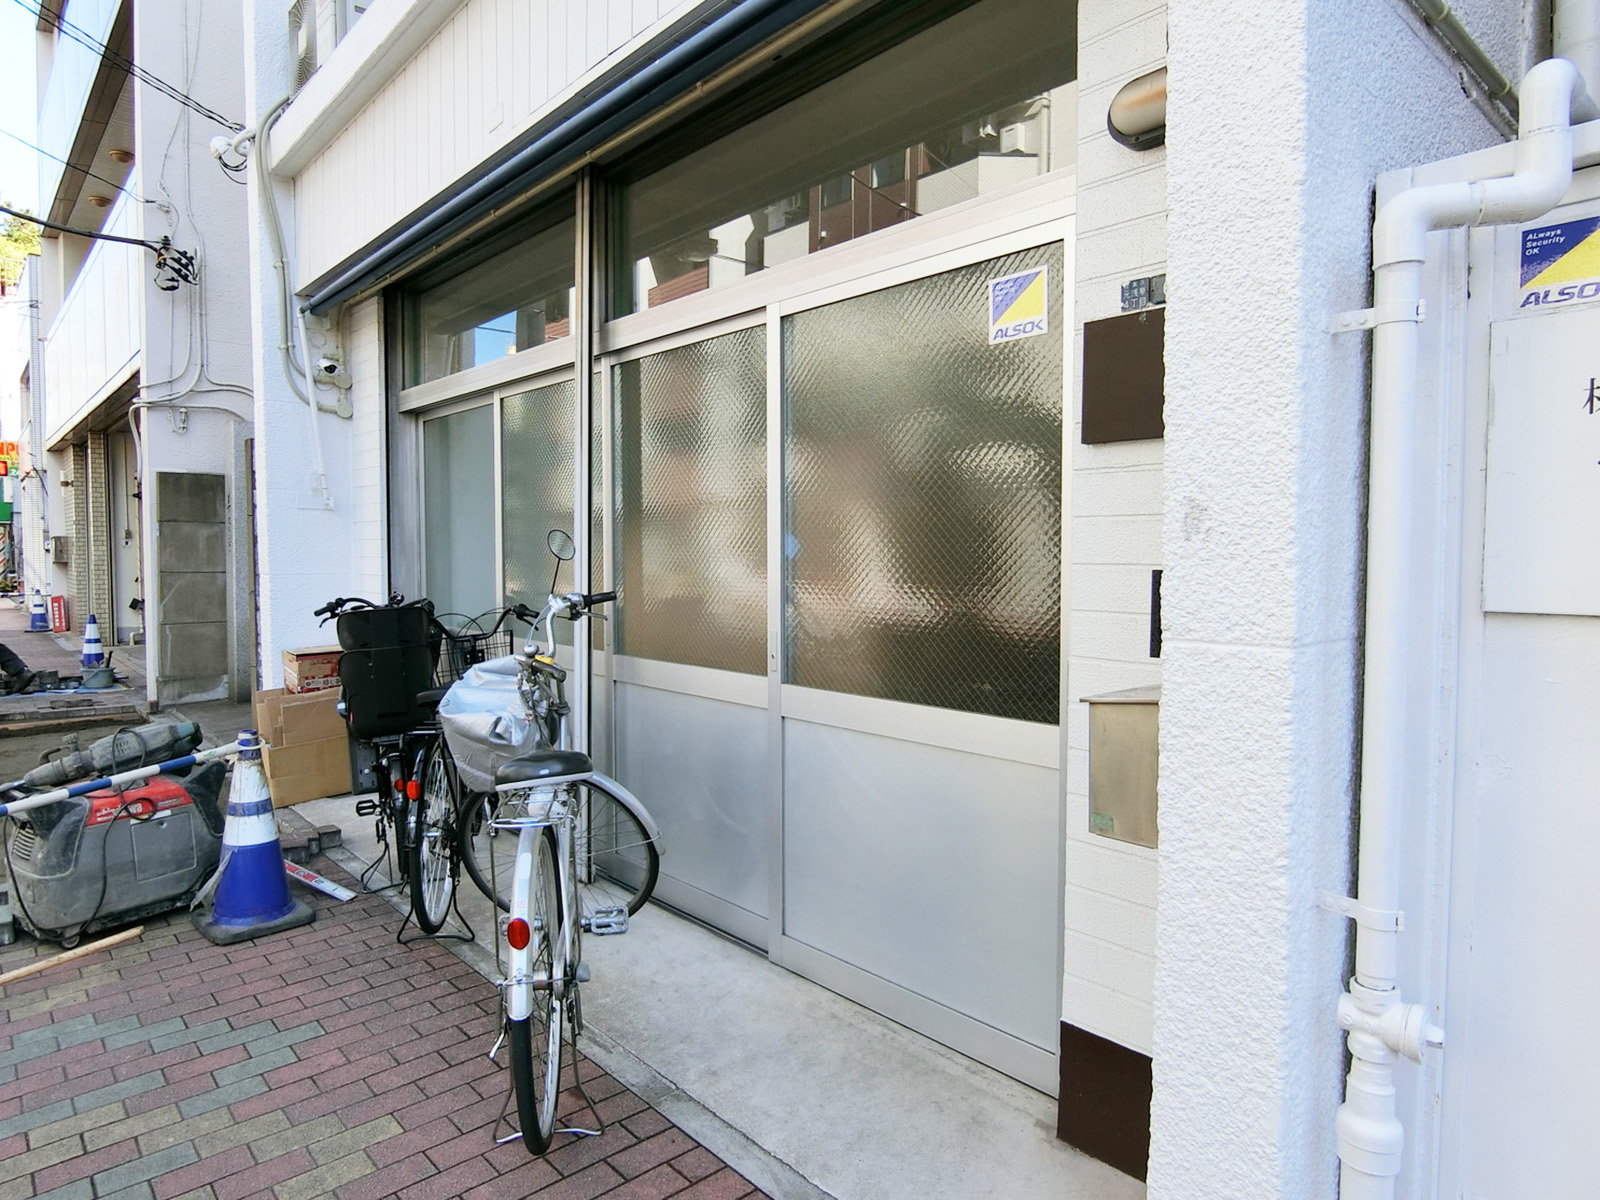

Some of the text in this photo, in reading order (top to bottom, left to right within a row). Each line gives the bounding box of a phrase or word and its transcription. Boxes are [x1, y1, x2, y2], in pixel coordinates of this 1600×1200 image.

[1525, 235, 1566, 249] Security
[1525, 247, 1540, 256] OK
[993, 319, 1044, 341] ALSOK
